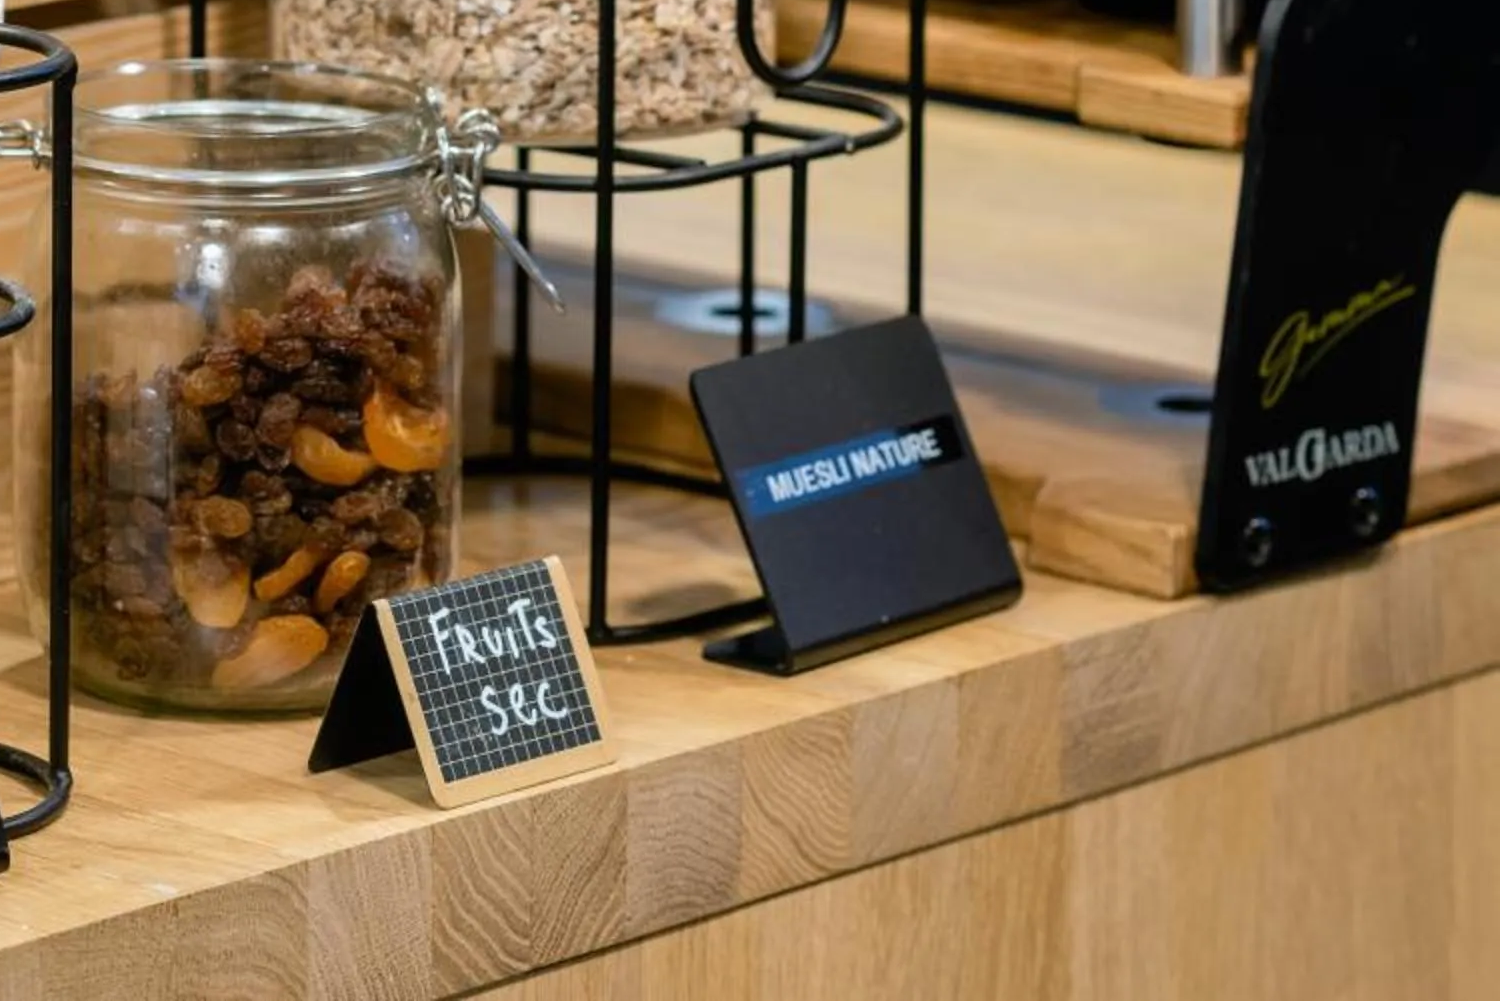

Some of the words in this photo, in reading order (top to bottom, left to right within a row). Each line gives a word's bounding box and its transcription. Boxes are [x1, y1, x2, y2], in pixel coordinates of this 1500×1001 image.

[765, 454, 850, 503] MUESLI
[848, 427, 943, 479] NATURE
[1244, 420, 1401, 486] VALGARDA
